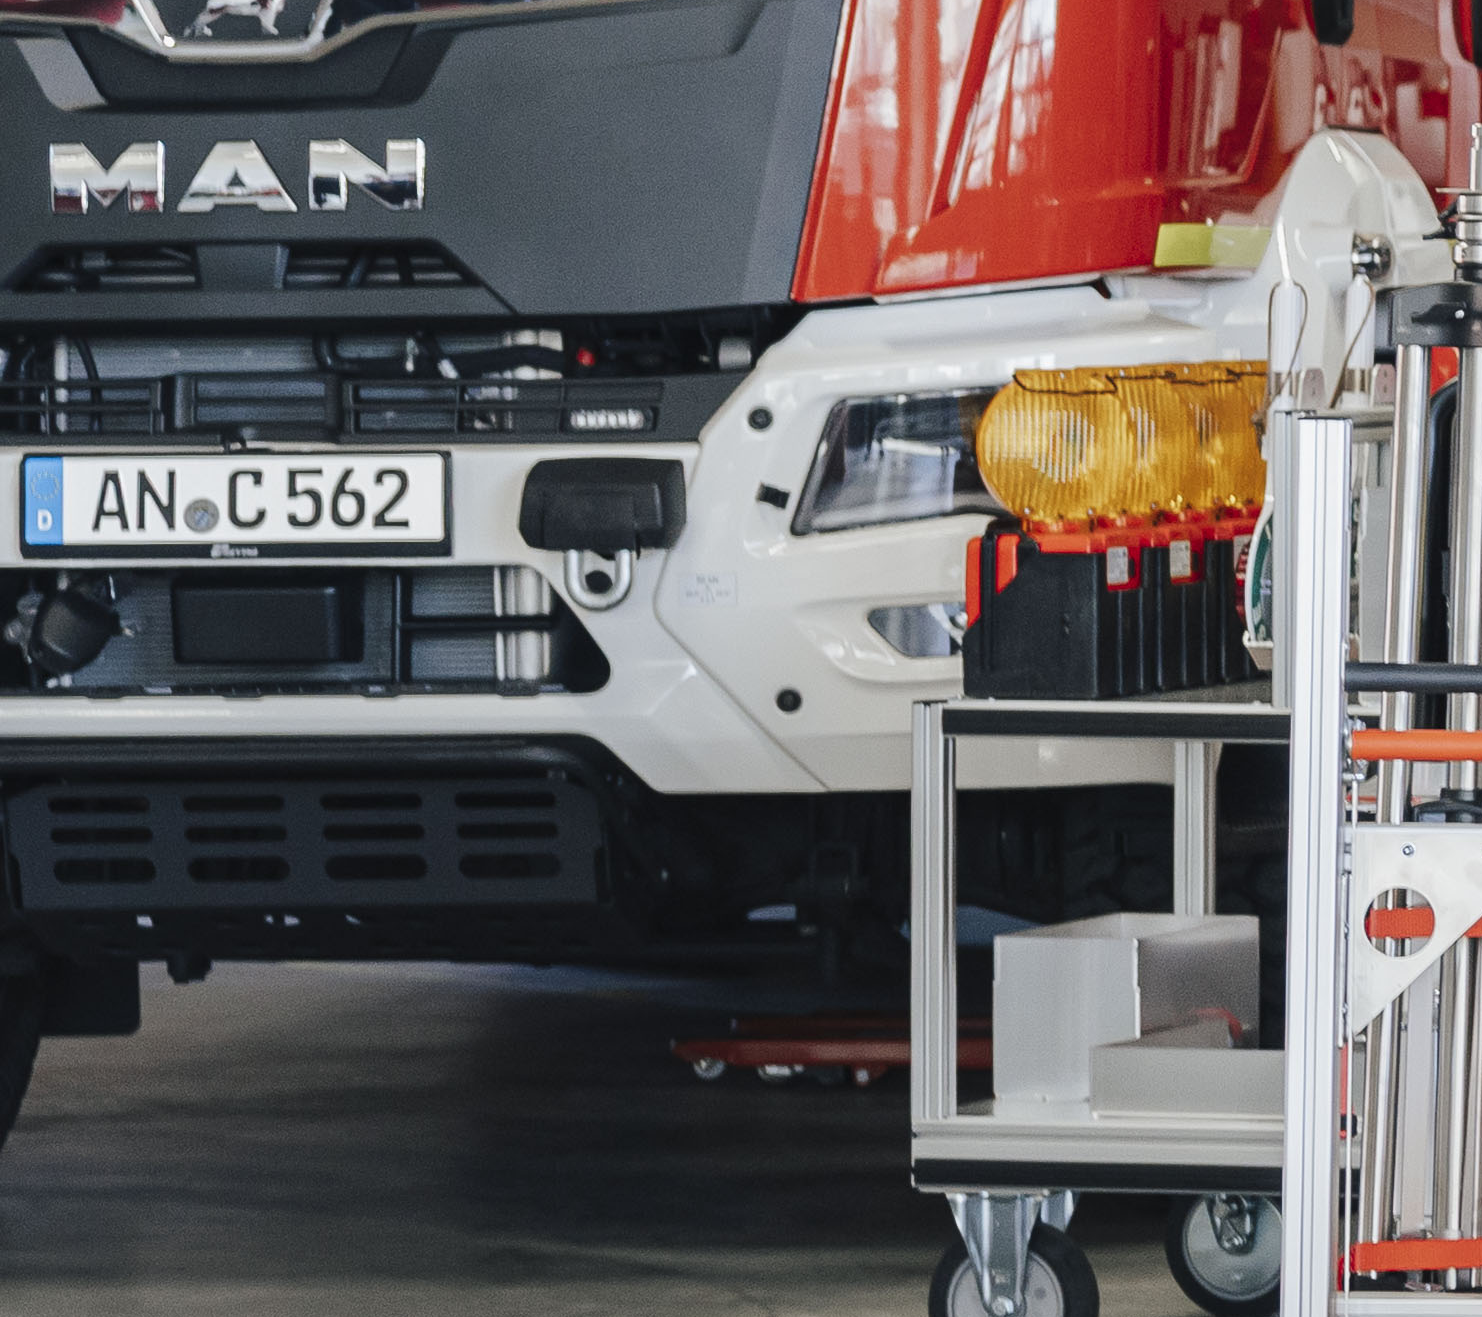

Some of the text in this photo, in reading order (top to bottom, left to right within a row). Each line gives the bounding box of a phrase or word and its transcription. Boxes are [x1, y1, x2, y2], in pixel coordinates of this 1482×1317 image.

[50, 138, 426, 213] MAN
[36, 509, 53, 532] D
[92, 467, 411, 532] AN C 562
